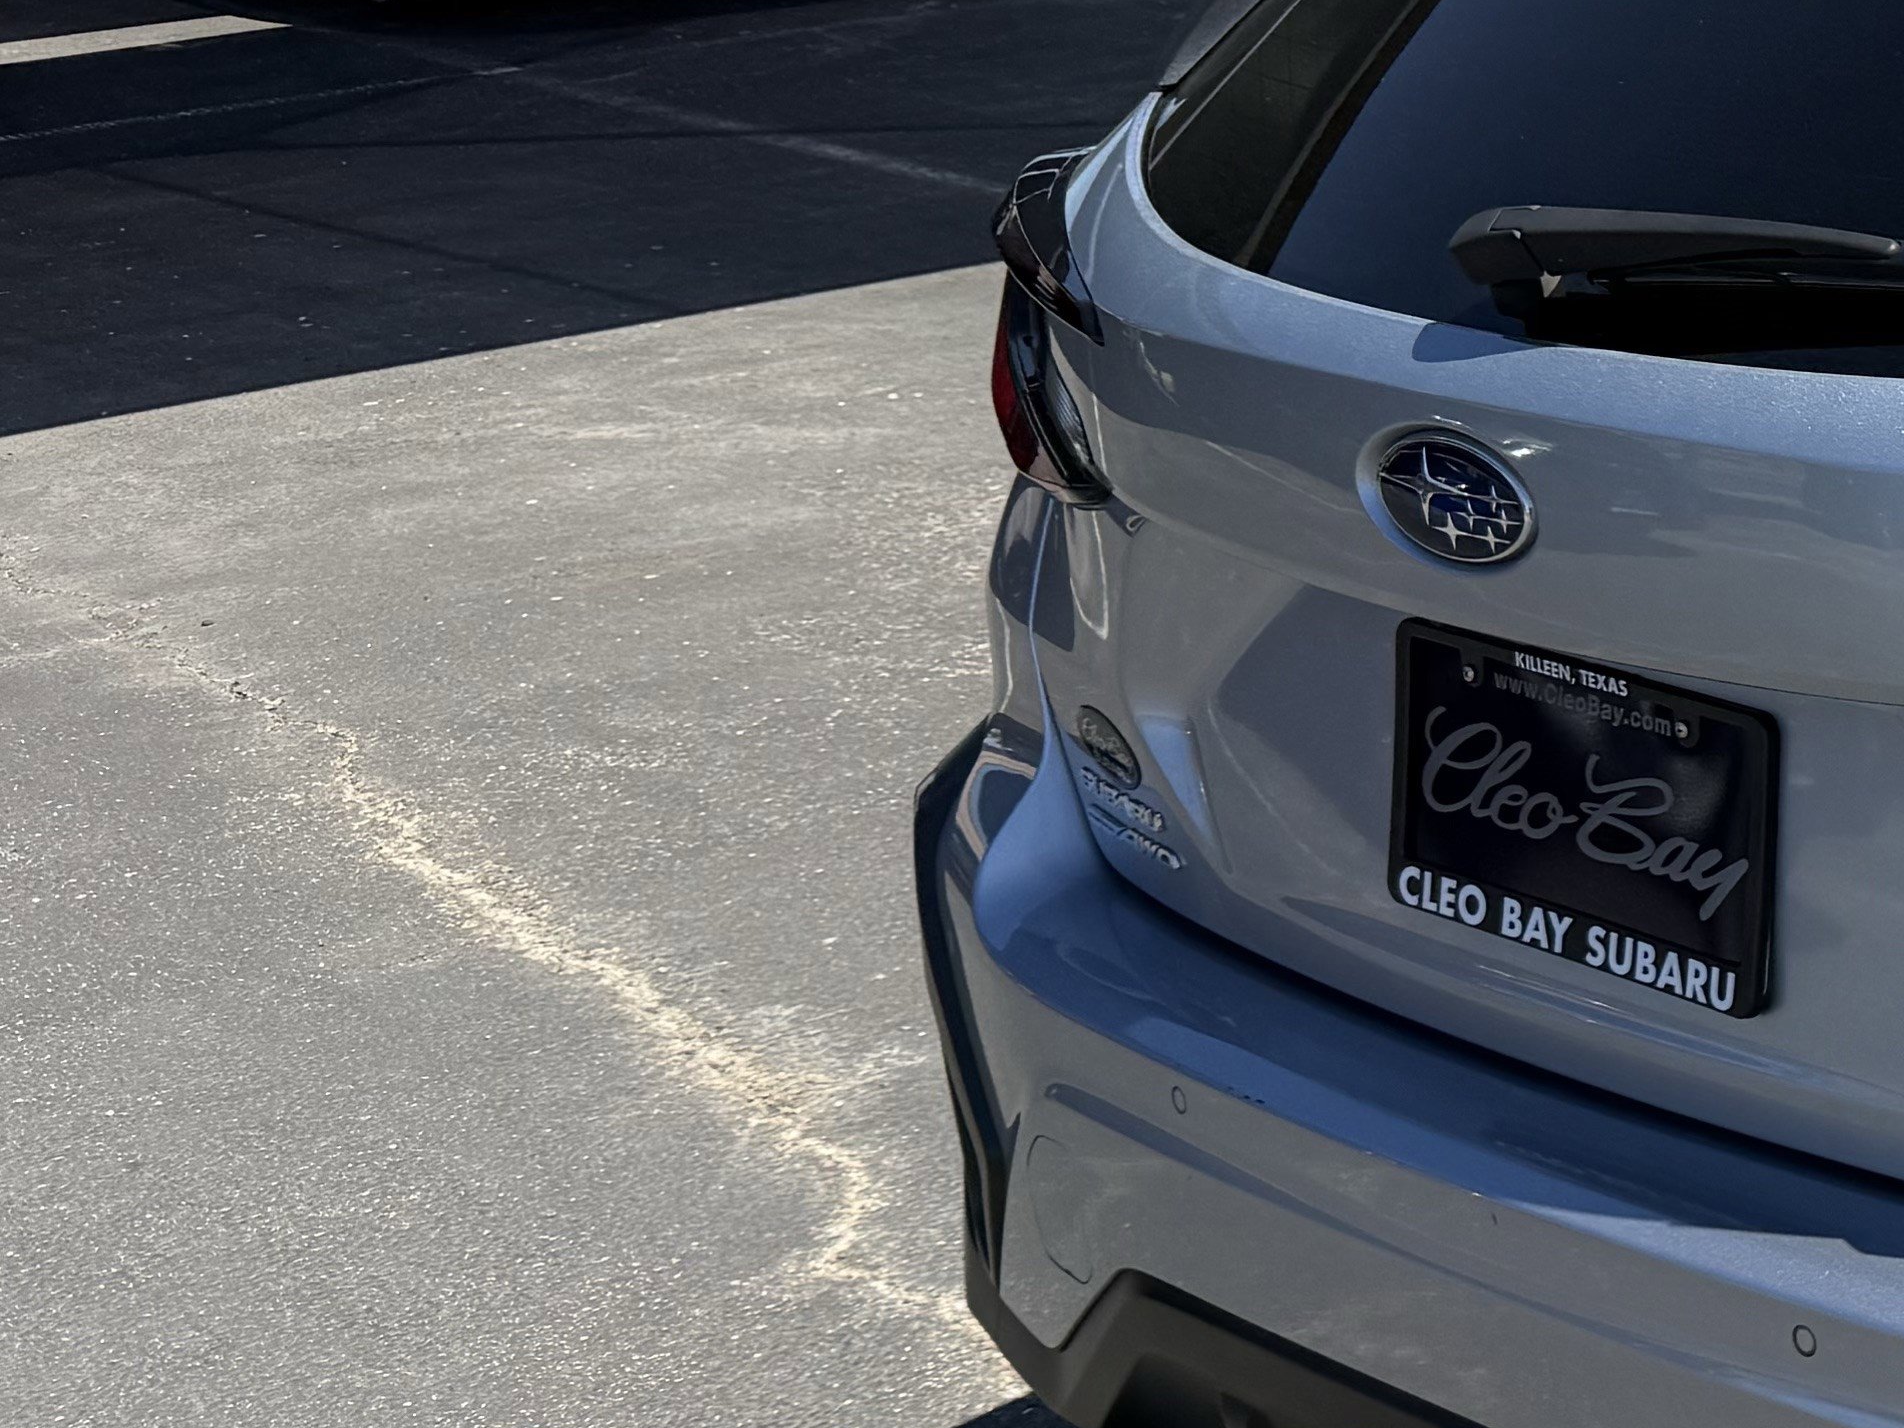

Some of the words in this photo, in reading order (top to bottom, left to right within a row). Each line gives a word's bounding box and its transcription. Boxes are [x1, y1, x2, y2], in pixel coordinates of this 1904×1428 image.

[1494, 670, 1672, 738] www.CleoBay.com
[1515, 652, 1577, 684] KILLEEN,
[1579, 669, 1628, 698] TEXAS
[1421, 705, 1579, 839] Cleo
[1575, 753, 1750, 922] Bay
[1399, 866, 1487, 927] CLEO
[1501, 896, 1573, 954] BAY
[1585, 927, 1737, 1012] SUBARU
